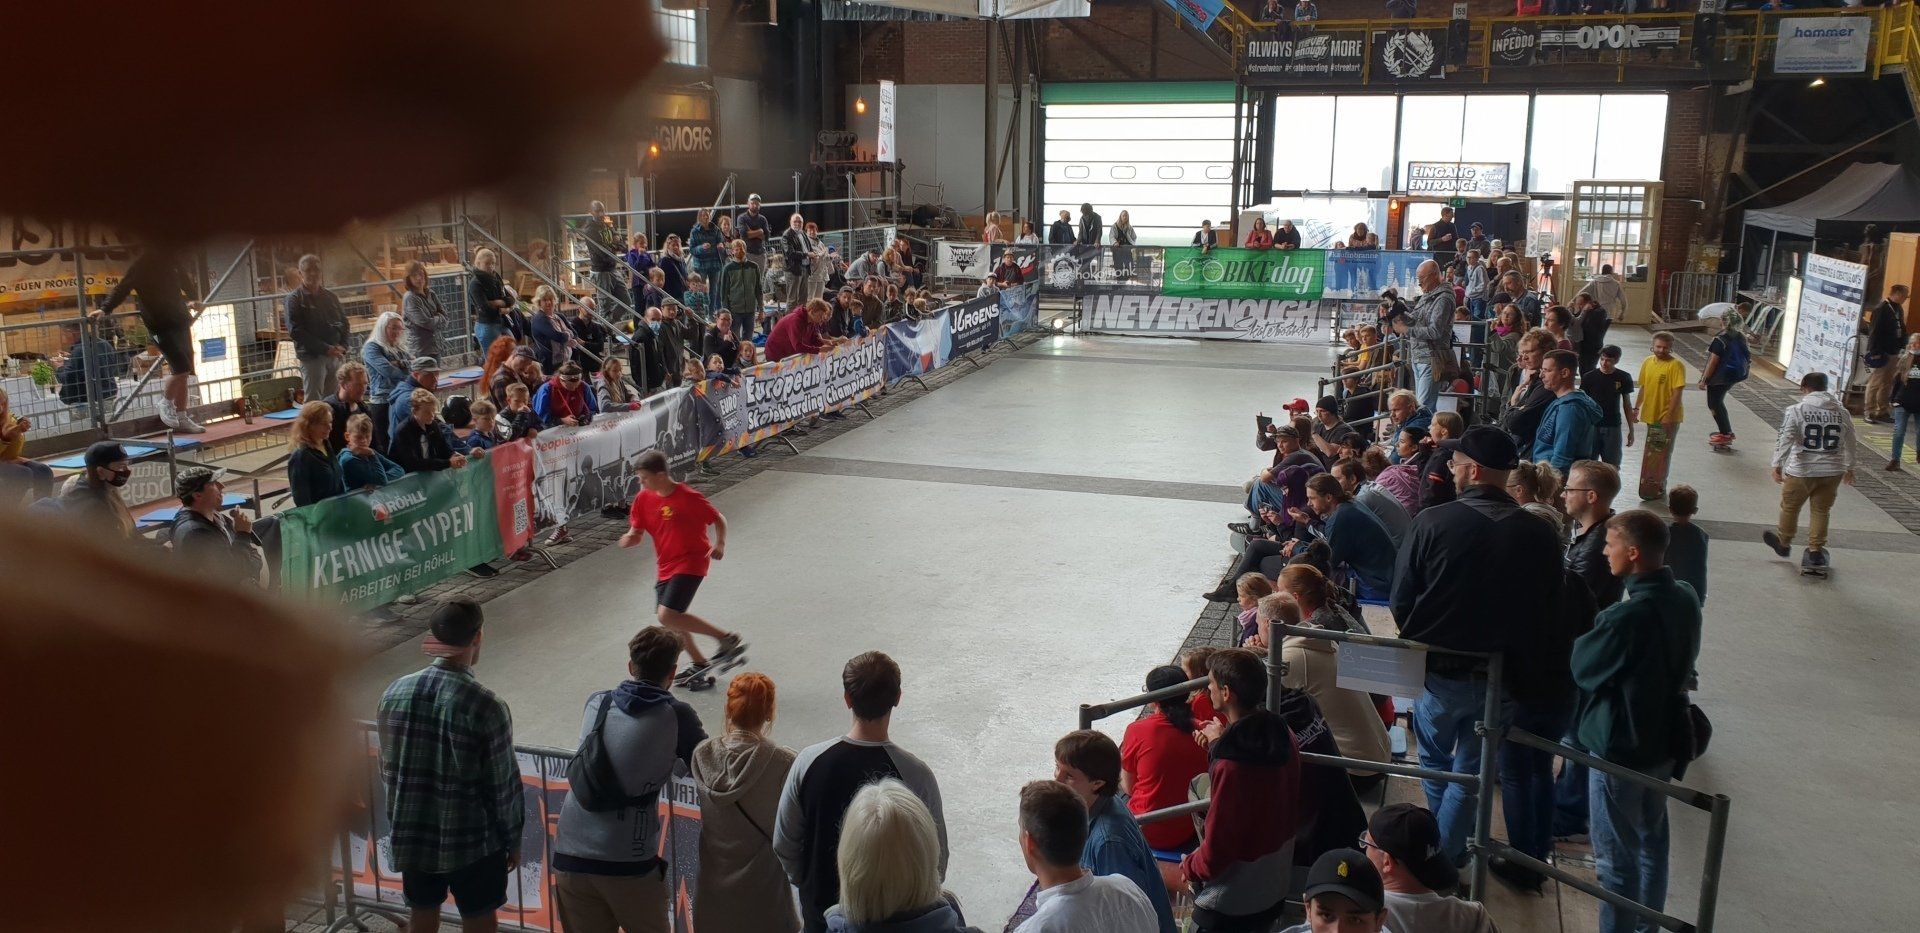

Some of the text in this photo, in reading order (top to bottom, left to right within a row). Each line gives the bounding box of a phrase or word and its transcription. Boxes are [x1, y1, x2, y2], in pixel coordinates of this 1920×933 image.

[1492, 34, 1535, 53] INPEDDO
[1576, 24, 1641, 50] OPOR
[1794, 26, 1855, 38] hammer
[1248, 40, 1362, 58] ALWAYS MORE
[1411, 166, 1476, 179] EINGANG
[1408, 179, 1478, 191] ENTRANCE
[14, 279, 42, 292] BUEN
[44, 276, 95, 289] PROVECO
[1222, 255, 1315, 295] BIKEdog
[745, 334, 885, 407] European Freestyle
[719, 393, 738, 416] EURO
[748, 393, 825, 431] Skateboarding
[1804, 423, 1842, 450] 86
[386, 490, 428, 514] RÖHLL
[313, 502, 474, 589] KERNIGE TYPEN
[339, 549, 457, 605] ARBEITEN BEI RÖHLL
